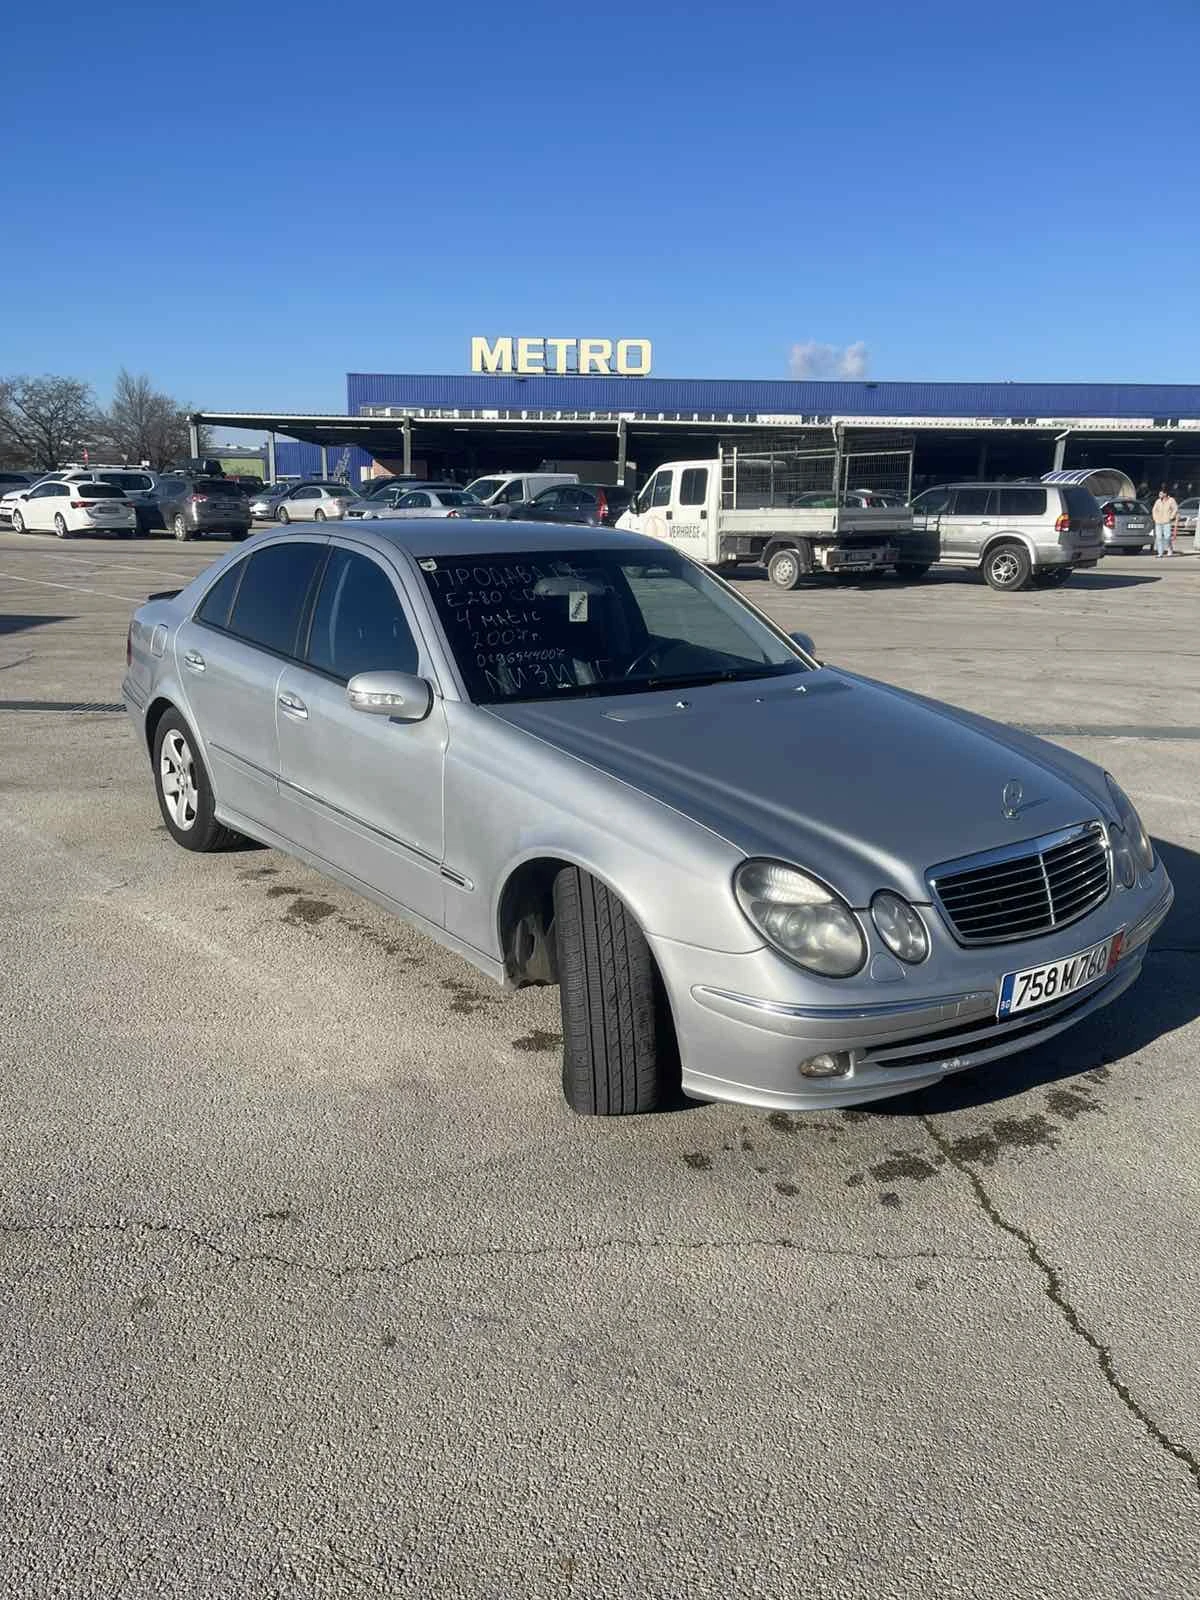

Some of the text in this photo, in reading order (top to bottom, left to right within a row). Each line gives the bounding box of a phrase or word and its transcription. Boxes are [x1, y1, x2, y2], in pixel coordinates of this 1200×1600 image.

[471, 336, 652, 375] METRO
[456, 609, 472, 632] 4
[1016, 967, 1058, 1007] 758
[1060, 960, 1077, 992] M
